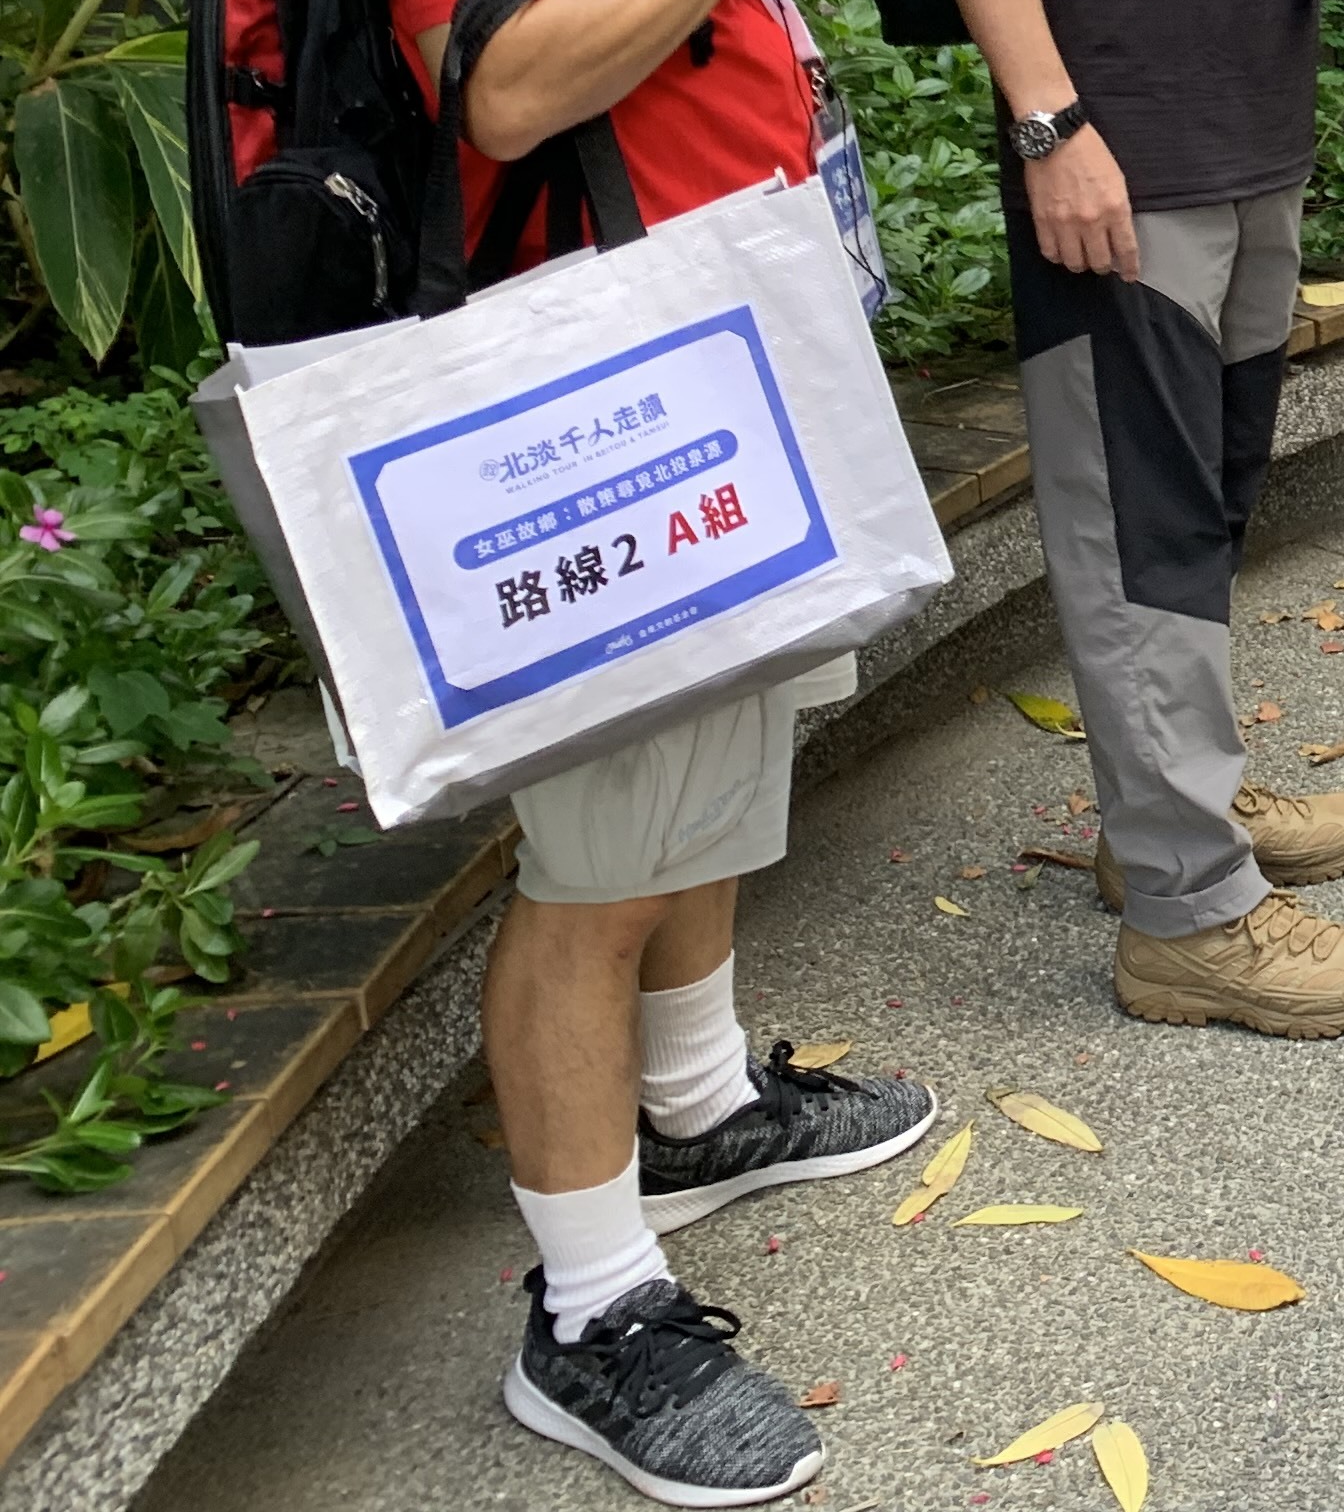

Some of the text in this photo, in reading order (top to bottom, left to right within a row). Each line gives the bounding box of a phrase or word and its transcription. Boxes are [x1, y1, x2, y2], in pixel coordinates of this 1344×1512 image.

[498, 392, 668, 484] 北淡千人走讀
[494, 481, 749, 630] 路線2 A組
